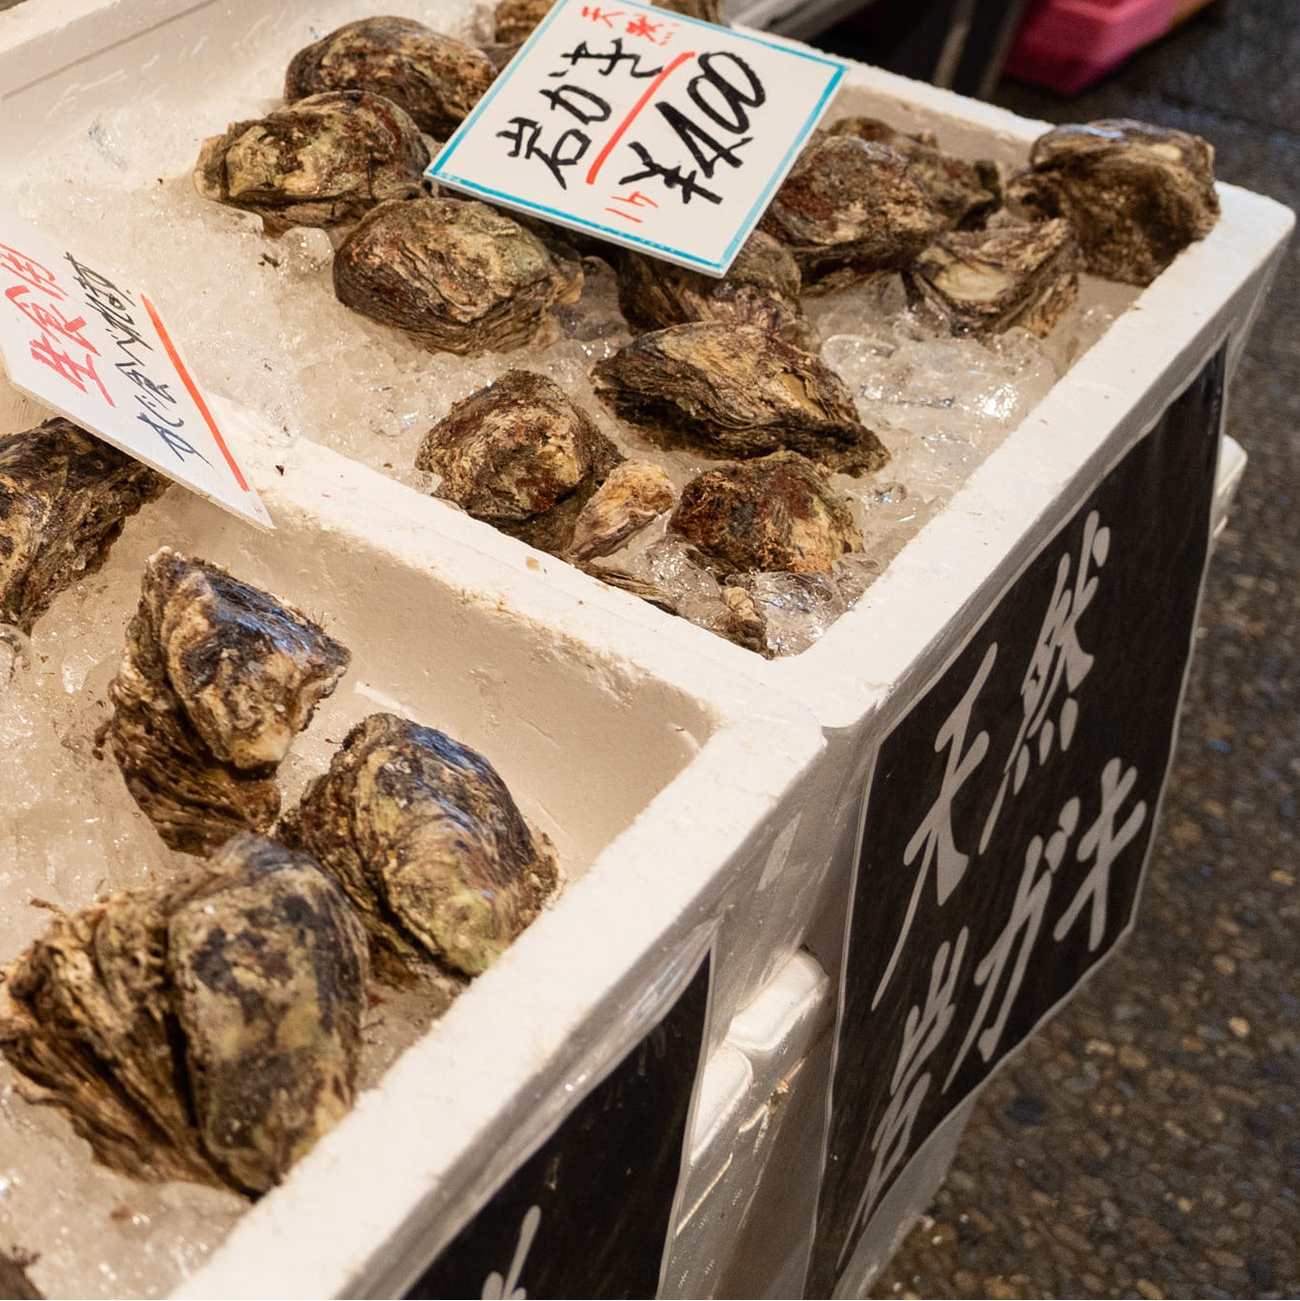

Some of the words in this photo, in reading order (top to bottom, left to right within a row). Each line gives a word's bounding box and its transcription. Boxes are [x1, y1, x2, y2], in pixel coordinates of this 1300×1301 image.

[581, 5, 682, 47] 天然
[496, 37, 665, 190] 岩かき
[618, 50, 767, 205] ¥400
[871, 508, 1112, 1011] 天然
